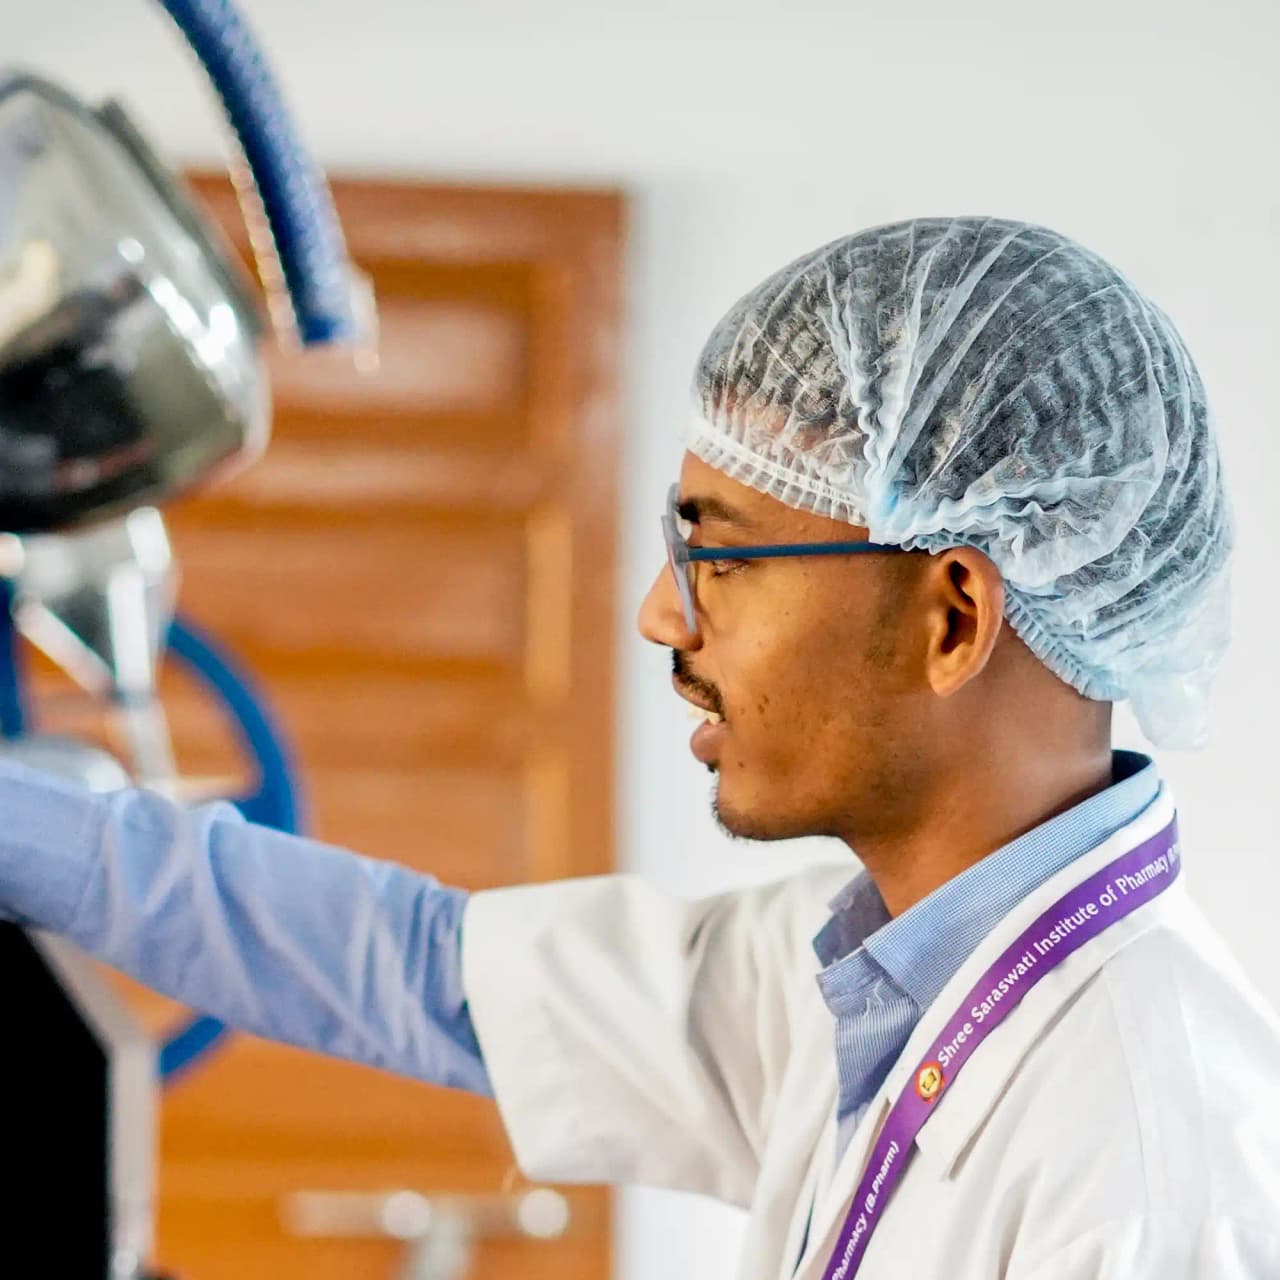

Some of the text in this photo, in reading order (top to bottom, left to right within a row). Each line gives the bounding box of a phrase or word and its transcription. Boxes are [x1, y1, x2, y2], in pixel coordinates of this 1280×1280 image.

[937, 1022, 974, 1067] Shree
[971, 951, 1037, 1023] Saraswati
[1033, 900, 1099, 955] Institute
[1099, 885, 1118, 906] of
[1115, 853, 1169, 895] Pharmacy
[864, 1140, 900, 1214] (B.Pharm)
